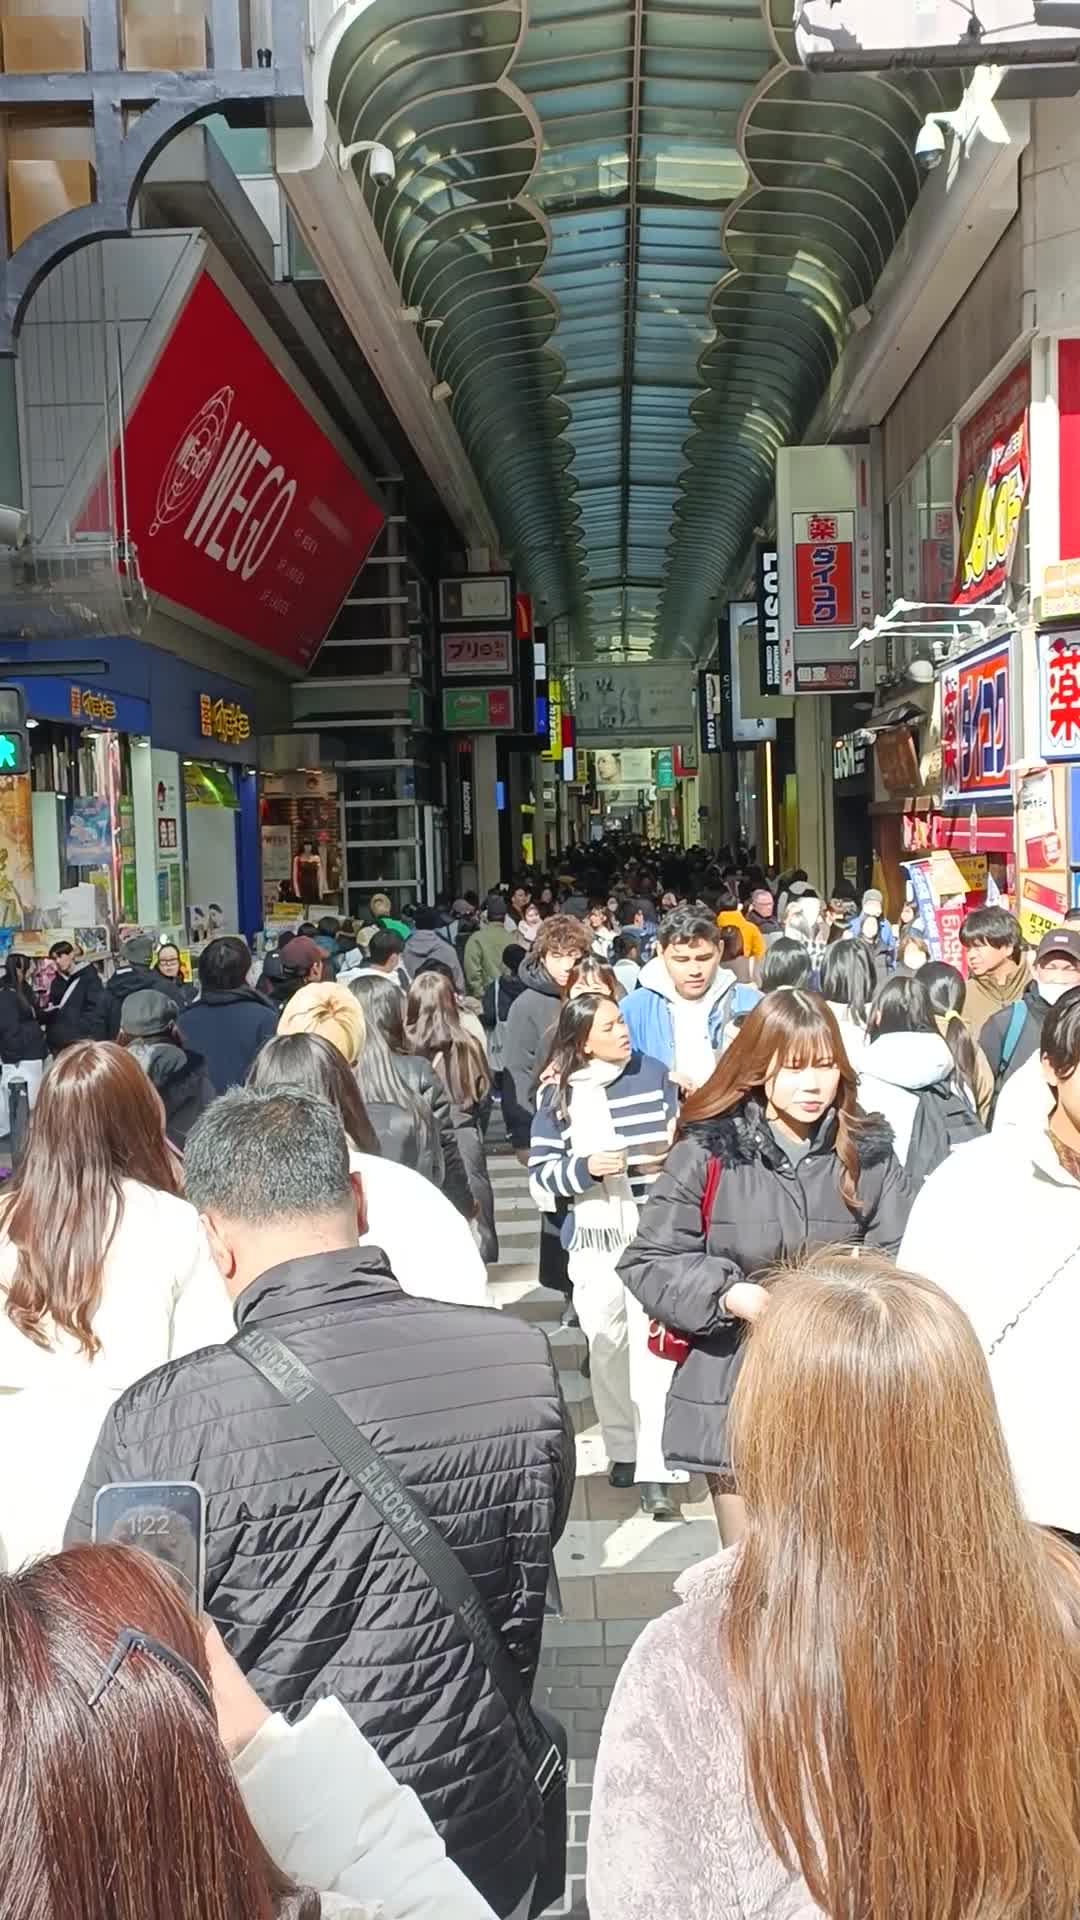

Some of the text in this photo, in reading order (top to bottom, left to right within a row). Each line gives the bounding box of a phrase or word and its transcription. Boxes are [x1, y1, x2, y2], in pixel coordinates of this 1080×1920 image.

[183, 421, 297, 581] WEGO
[808, 514, 838, 542] 薬
[811, 544, 838, 623] ダイコク
[962, 667, 1008, 783] ダイコク
